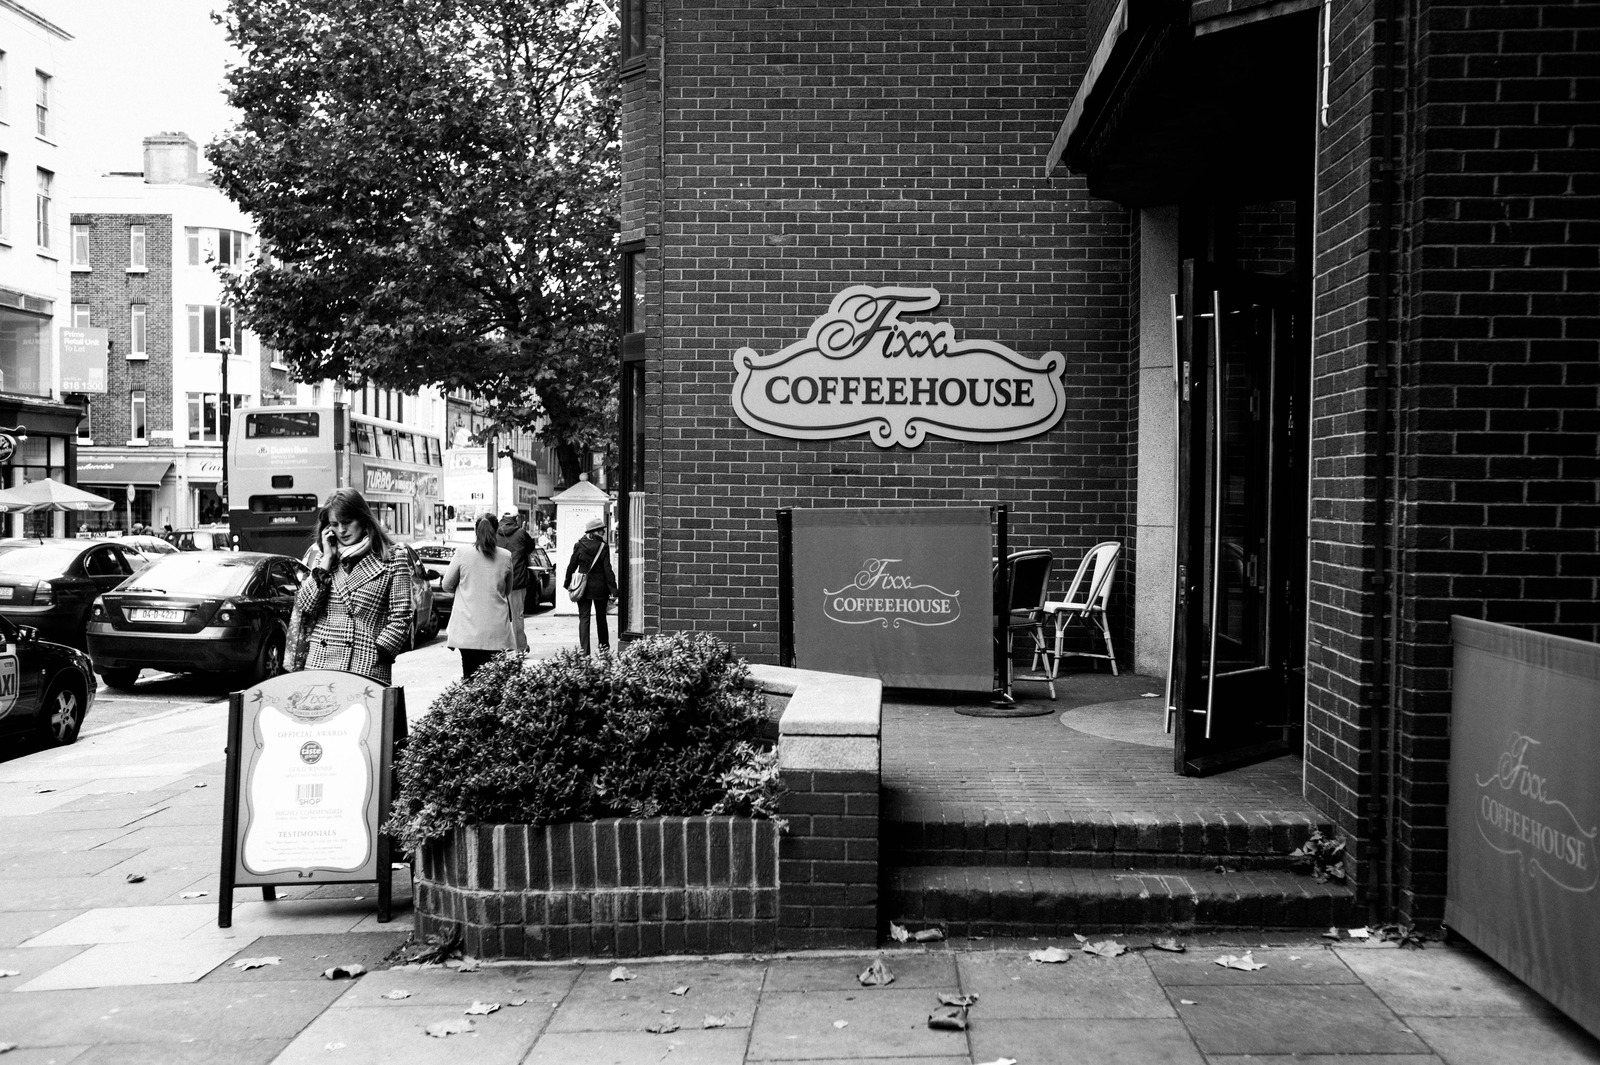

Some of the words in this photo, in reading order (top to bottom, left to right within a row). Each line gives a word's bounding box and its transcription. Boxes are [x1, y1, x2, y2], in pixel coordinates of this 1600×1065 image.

[816, 293, 948, 360] Fixx
[63, 330, 85, 338] Prime
[63, 337, 84, 345] Retail
[84, 338, 100, 346] Unit
[63, 344, 73, 352] To
[74, 345, 86, 353] Let
[63, 381, 80, 390] 618
[82, 381, 104, 391] 1300
[764, 375, 1035, 408] COFFEEHOUSE
[199, 461, 223, 472] Car
[366, 469, 392, 490] TURBO
[854, 557, 912, 591] Fixx
[833, 597, 951, 614] COFFEEHOUSE
[142, 610, 178, 619] 04-D-4221
[277, 731, 314, 739] OFFICIAL
[316, 729, 348, 738] AWARDS
[301, 747, 322, 755] taste
[1498, 730, 1547, 803] Fixx
[298, 798, 321, 806] SHOP
[277, 829, 338, 839] TESTIMONIALS
[1481, 794, 1588, 871] COFFEEHOUSE
